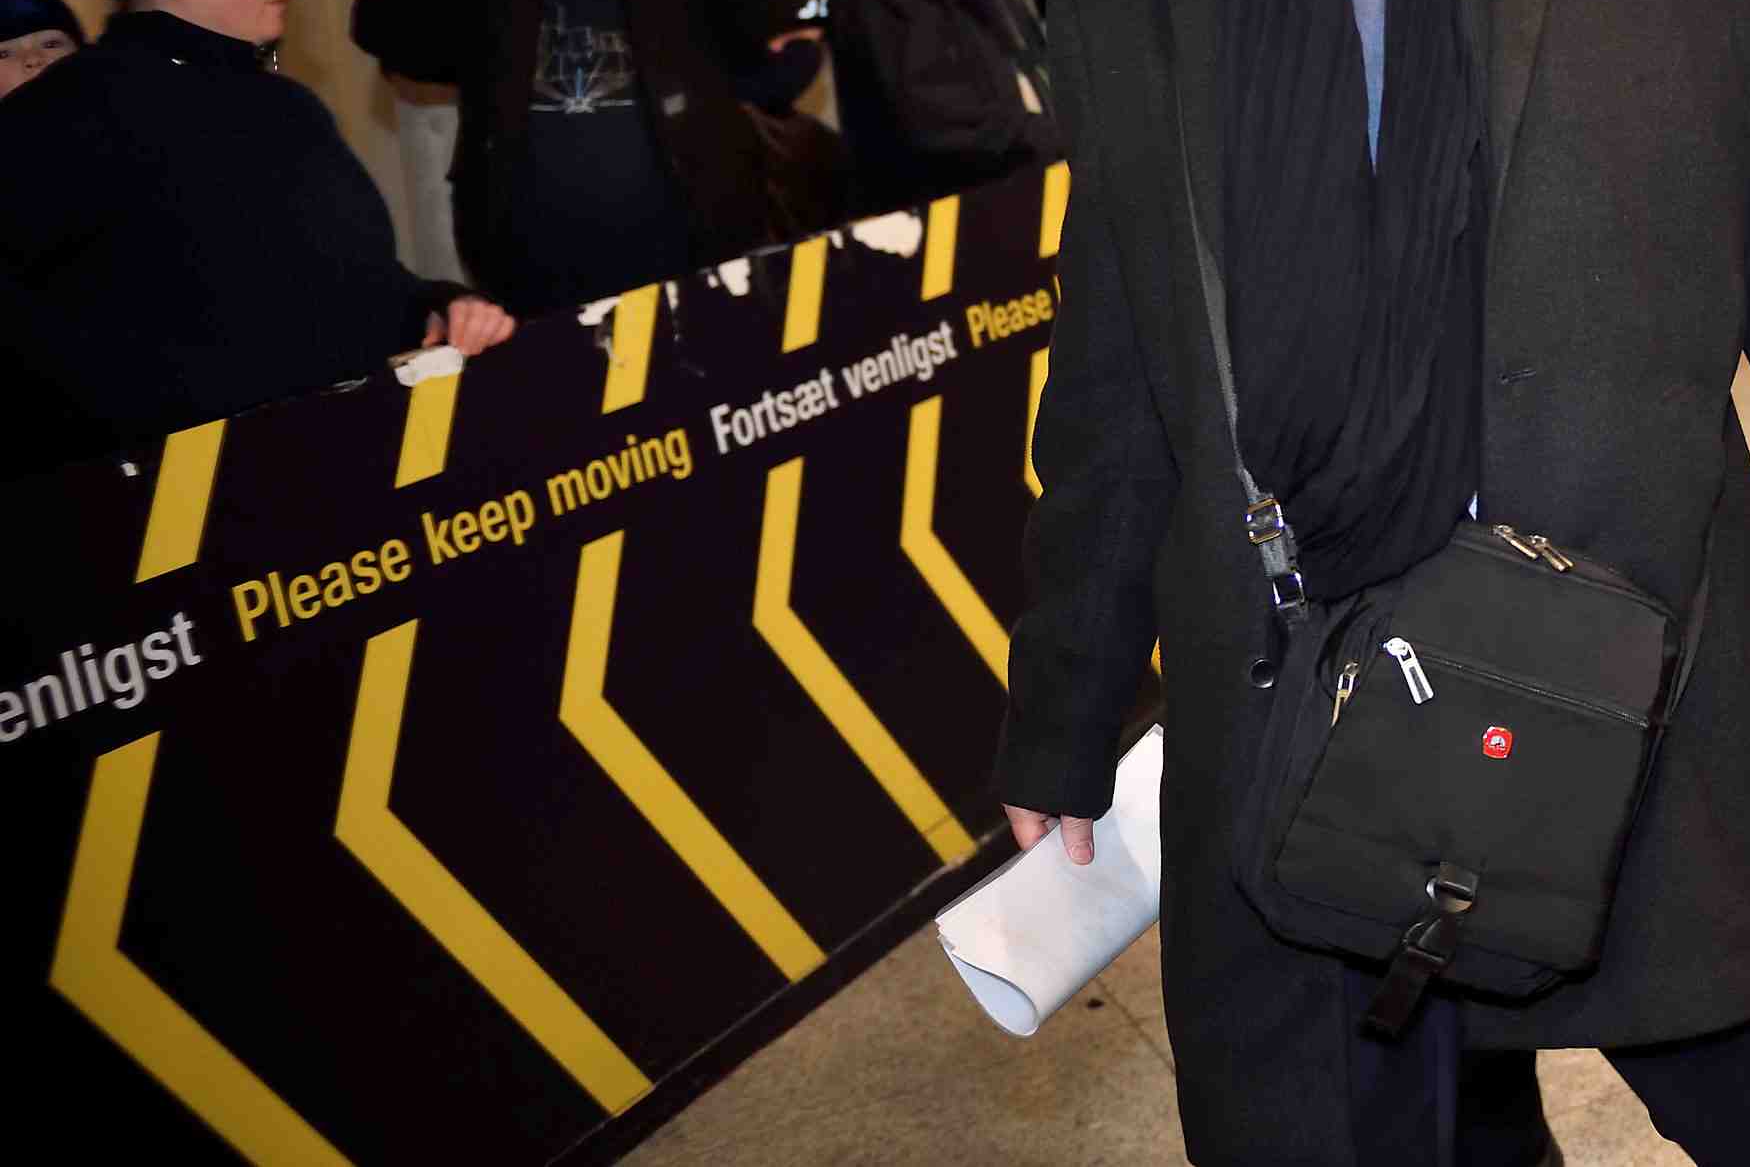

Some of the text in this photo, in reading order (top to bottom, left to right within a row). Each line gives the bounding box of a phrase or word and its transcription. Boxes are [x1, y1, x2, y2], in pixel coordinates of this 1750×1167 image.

[232, 538, 412, 643] Please
[421, 489, 536, 566] keep
[546, 428, 693, 516] moving
[710, 367, 839, 454] Fortsæt
[842, 320, 958, 399] venligst
[966, 288, 1054, 347] Please
